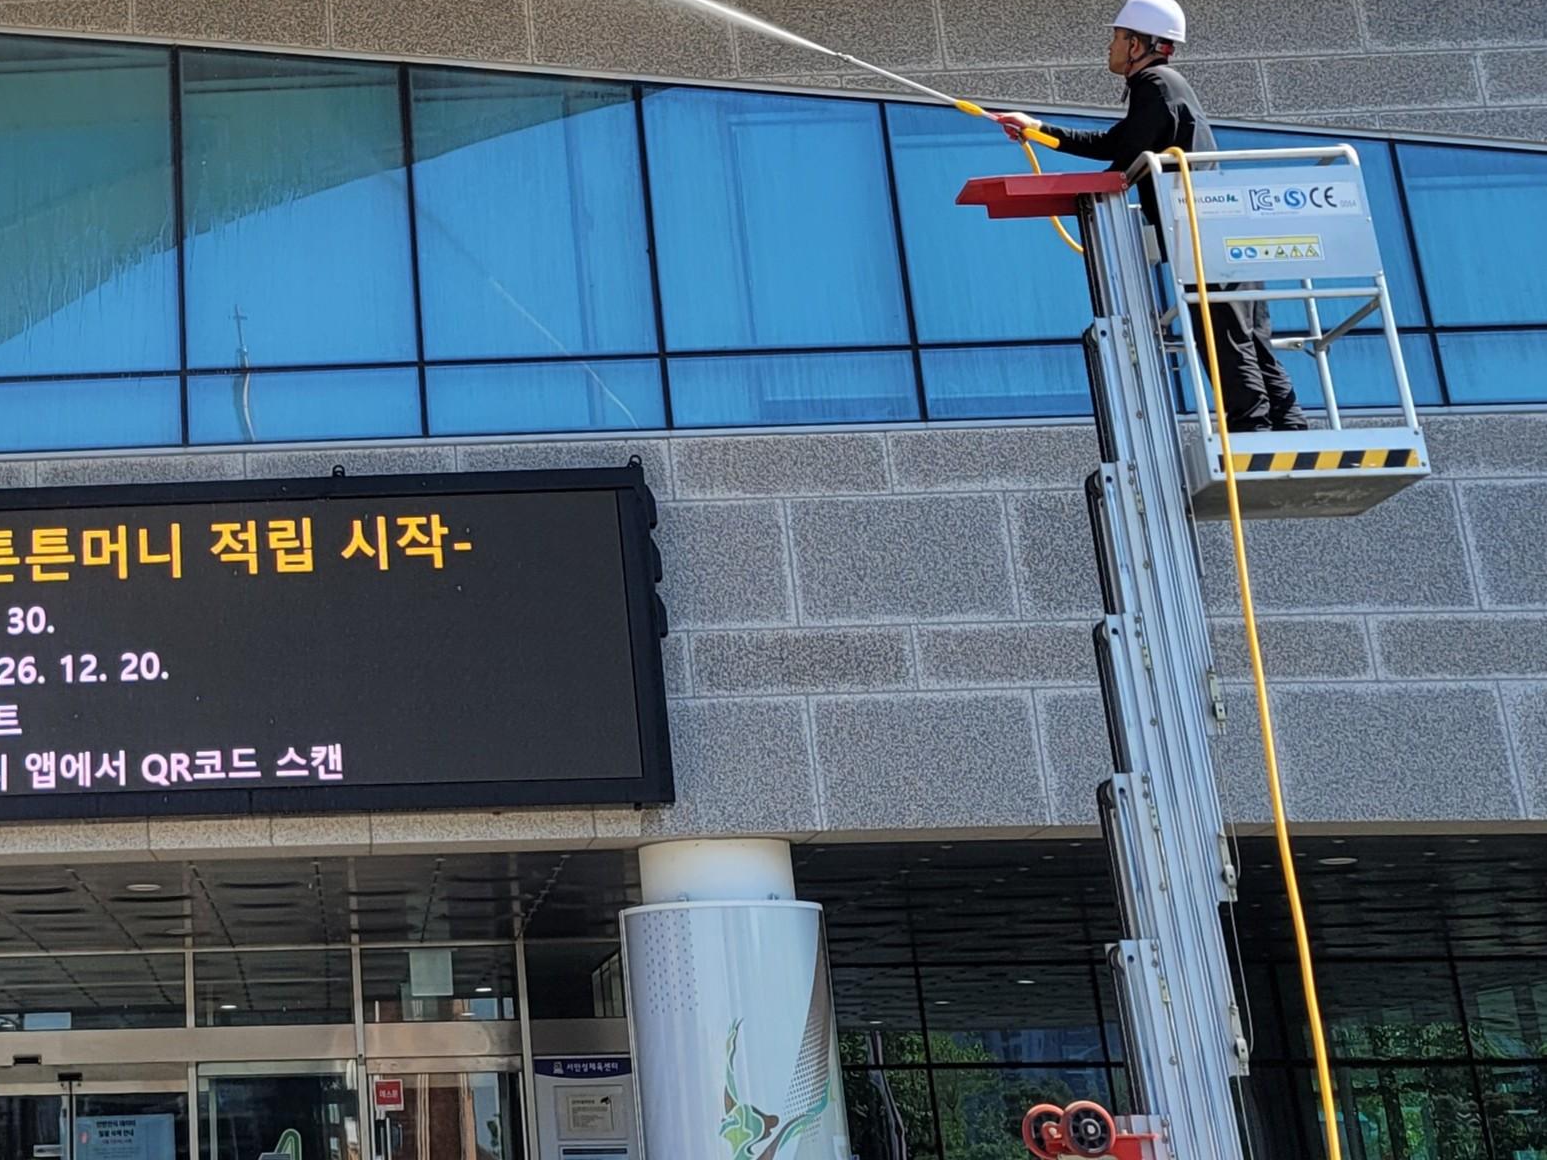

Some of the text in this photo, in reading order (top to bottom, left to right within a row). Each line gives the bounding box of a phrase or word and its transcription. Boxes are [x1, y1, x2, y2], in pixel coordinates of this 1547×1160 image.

[1309, 186, 1338, 209] CE
[210, 517, 314, 575] 적립
[341, 514, 472, 571] 시작-
[7, 606, 55, 636] 30.
[61, 654, 108, 684] 12.
[121, 652, 169, 682] 20.
[25, 750, 126, 790] 앱에서
[141, 748, 262, 787] QR코드
[276, 744, 344, 781] 스캔
